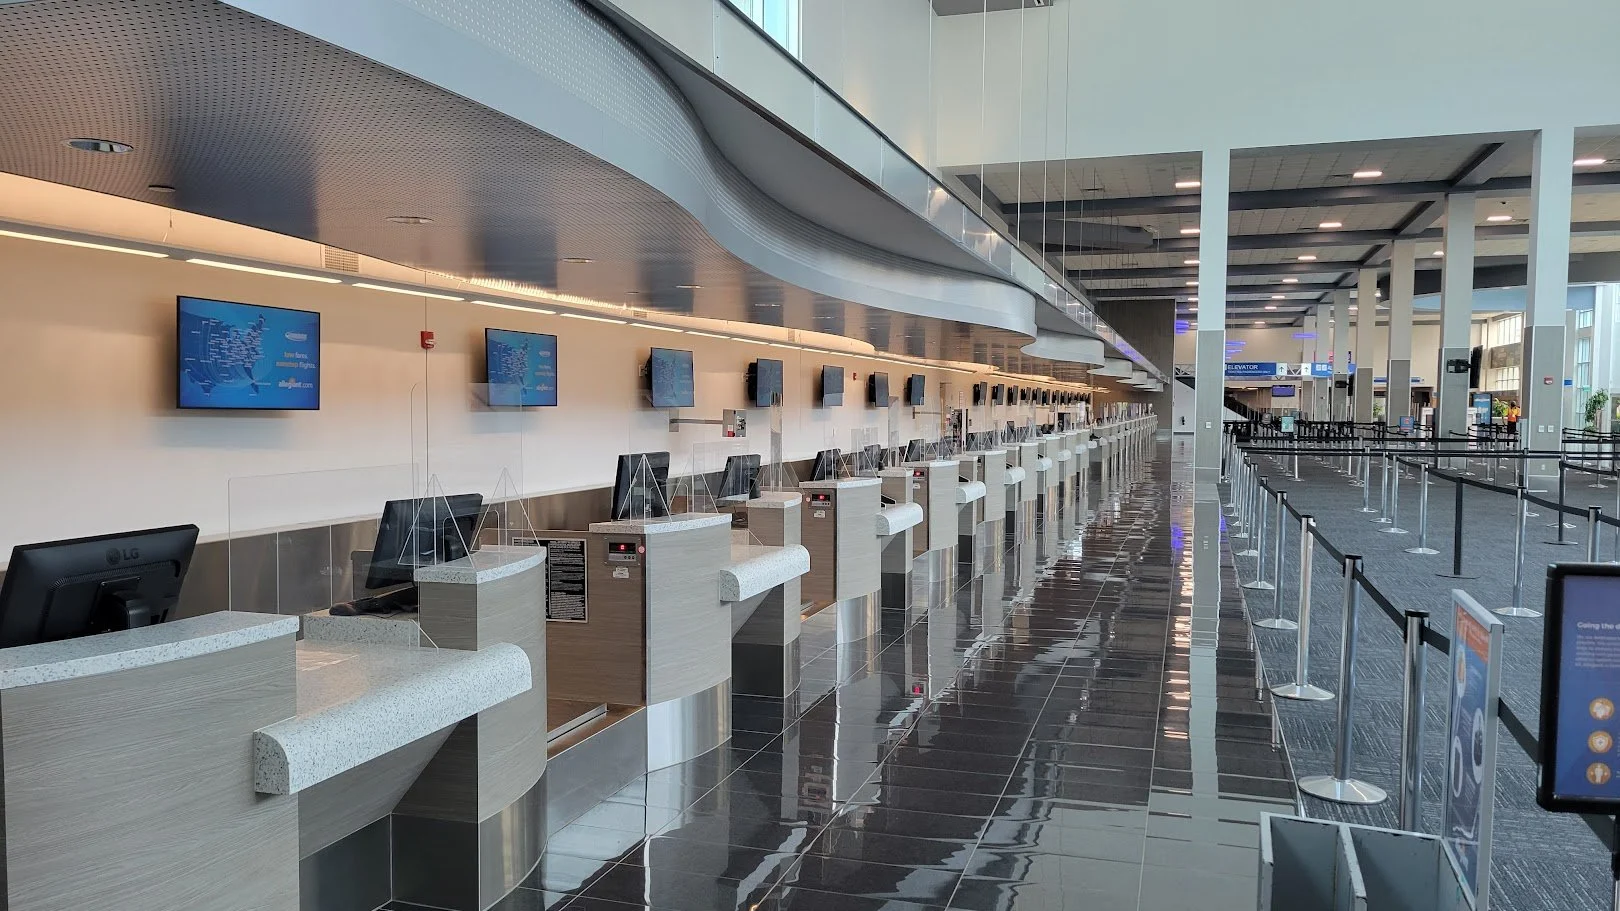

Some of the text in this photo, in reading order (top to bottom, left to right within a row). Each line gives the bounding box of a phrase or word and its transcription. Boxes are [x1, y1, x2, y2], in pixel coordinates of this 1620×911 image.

[122, 547, 139, 560] LG
[1576, 621, 1600, 630] Going
[1601, 622, 1614, 630] the
